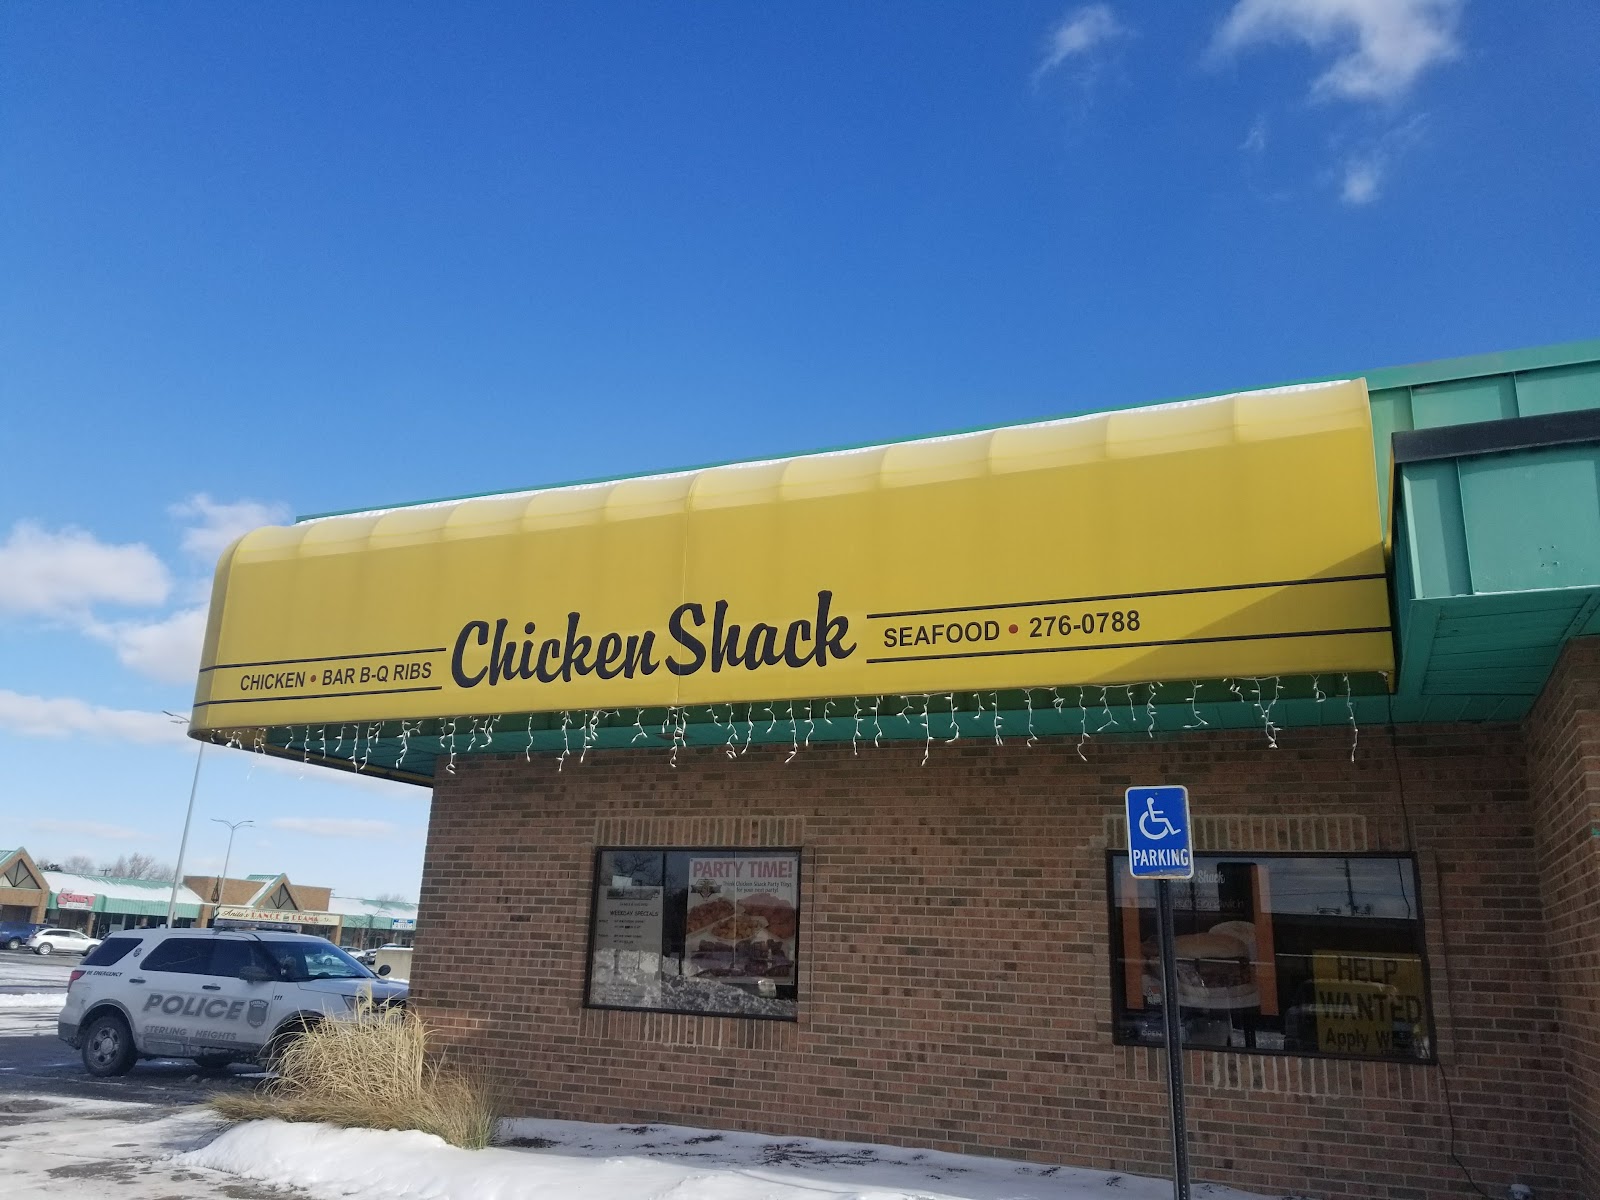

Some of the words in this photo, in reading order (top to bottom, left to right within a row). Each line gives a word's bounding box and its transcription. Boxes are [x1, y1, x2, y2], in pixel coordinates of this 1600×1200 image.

[451, 612, 660, 689] Chicken
[665, 590, 857, 676] Shack
[883, 620, 1000, 648] SEAFOOD
[1029, 610, 1140, 638] 276-0788
[240, 671, 306, 691] CHICKEN
[321, 668, 355, 686] BAR
[359, 666, 389, 684] B-Q
[393, 662, 432, 681] RIBS
[693, 861, 743, 878] PARTY
[748, 861, 793, 878] TIME!
[1132, 848, 1189, 867] PARKING
[1337, 957, 1398, 984] HELP
[143, 993, 245, 1020] POLICE
[1319, 991, 1421, 1023] WANTED
[144, 1025, 187, 1036] STERLING
[194, 1030, 237, 1040] HEIGHTS
[1326, 1027, 1368, 1052] Apply
